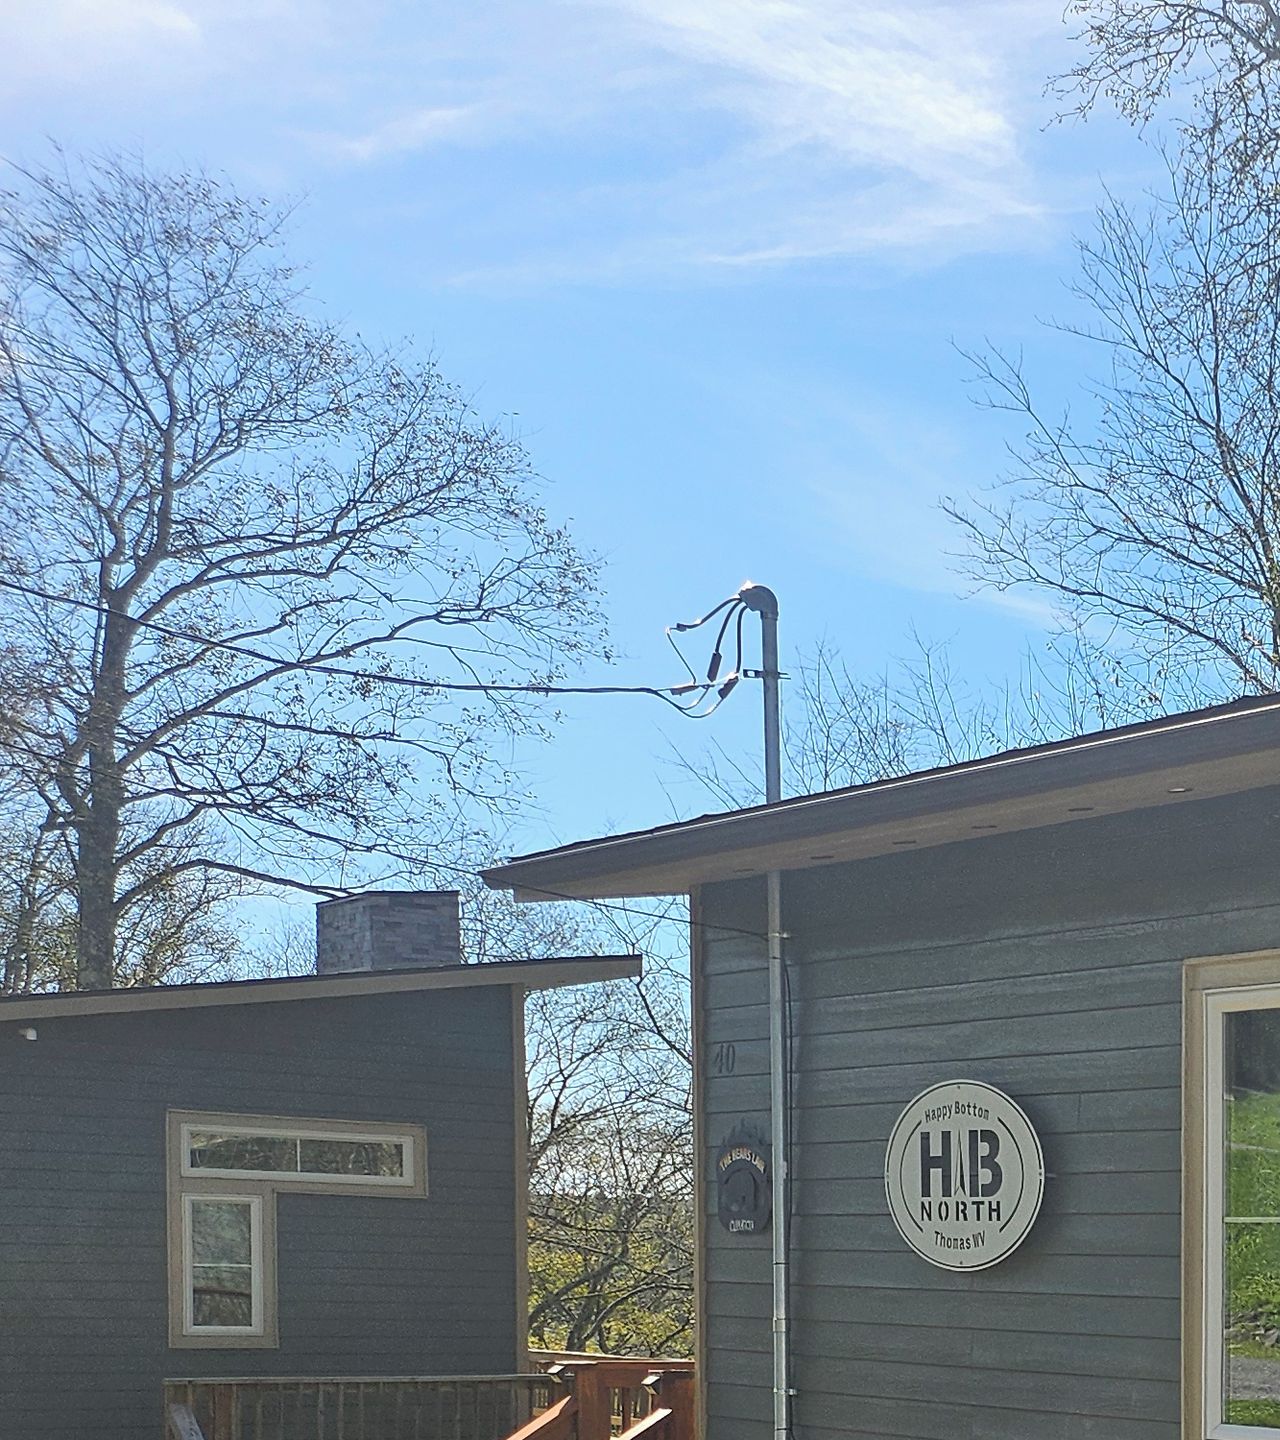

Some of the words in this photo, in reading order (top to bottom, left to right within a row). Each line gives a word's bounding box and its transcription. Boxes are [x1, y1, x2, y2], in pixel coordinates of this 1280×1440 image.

[924, 1103, 953, 1123] Happy
[954, 1101, 990, 1121] Bottom
[921, 1200, 1001, 1222] NORTH
[934, 1230, 972, 1251] Thomas
[972, 1230, 986, 1248] WV
